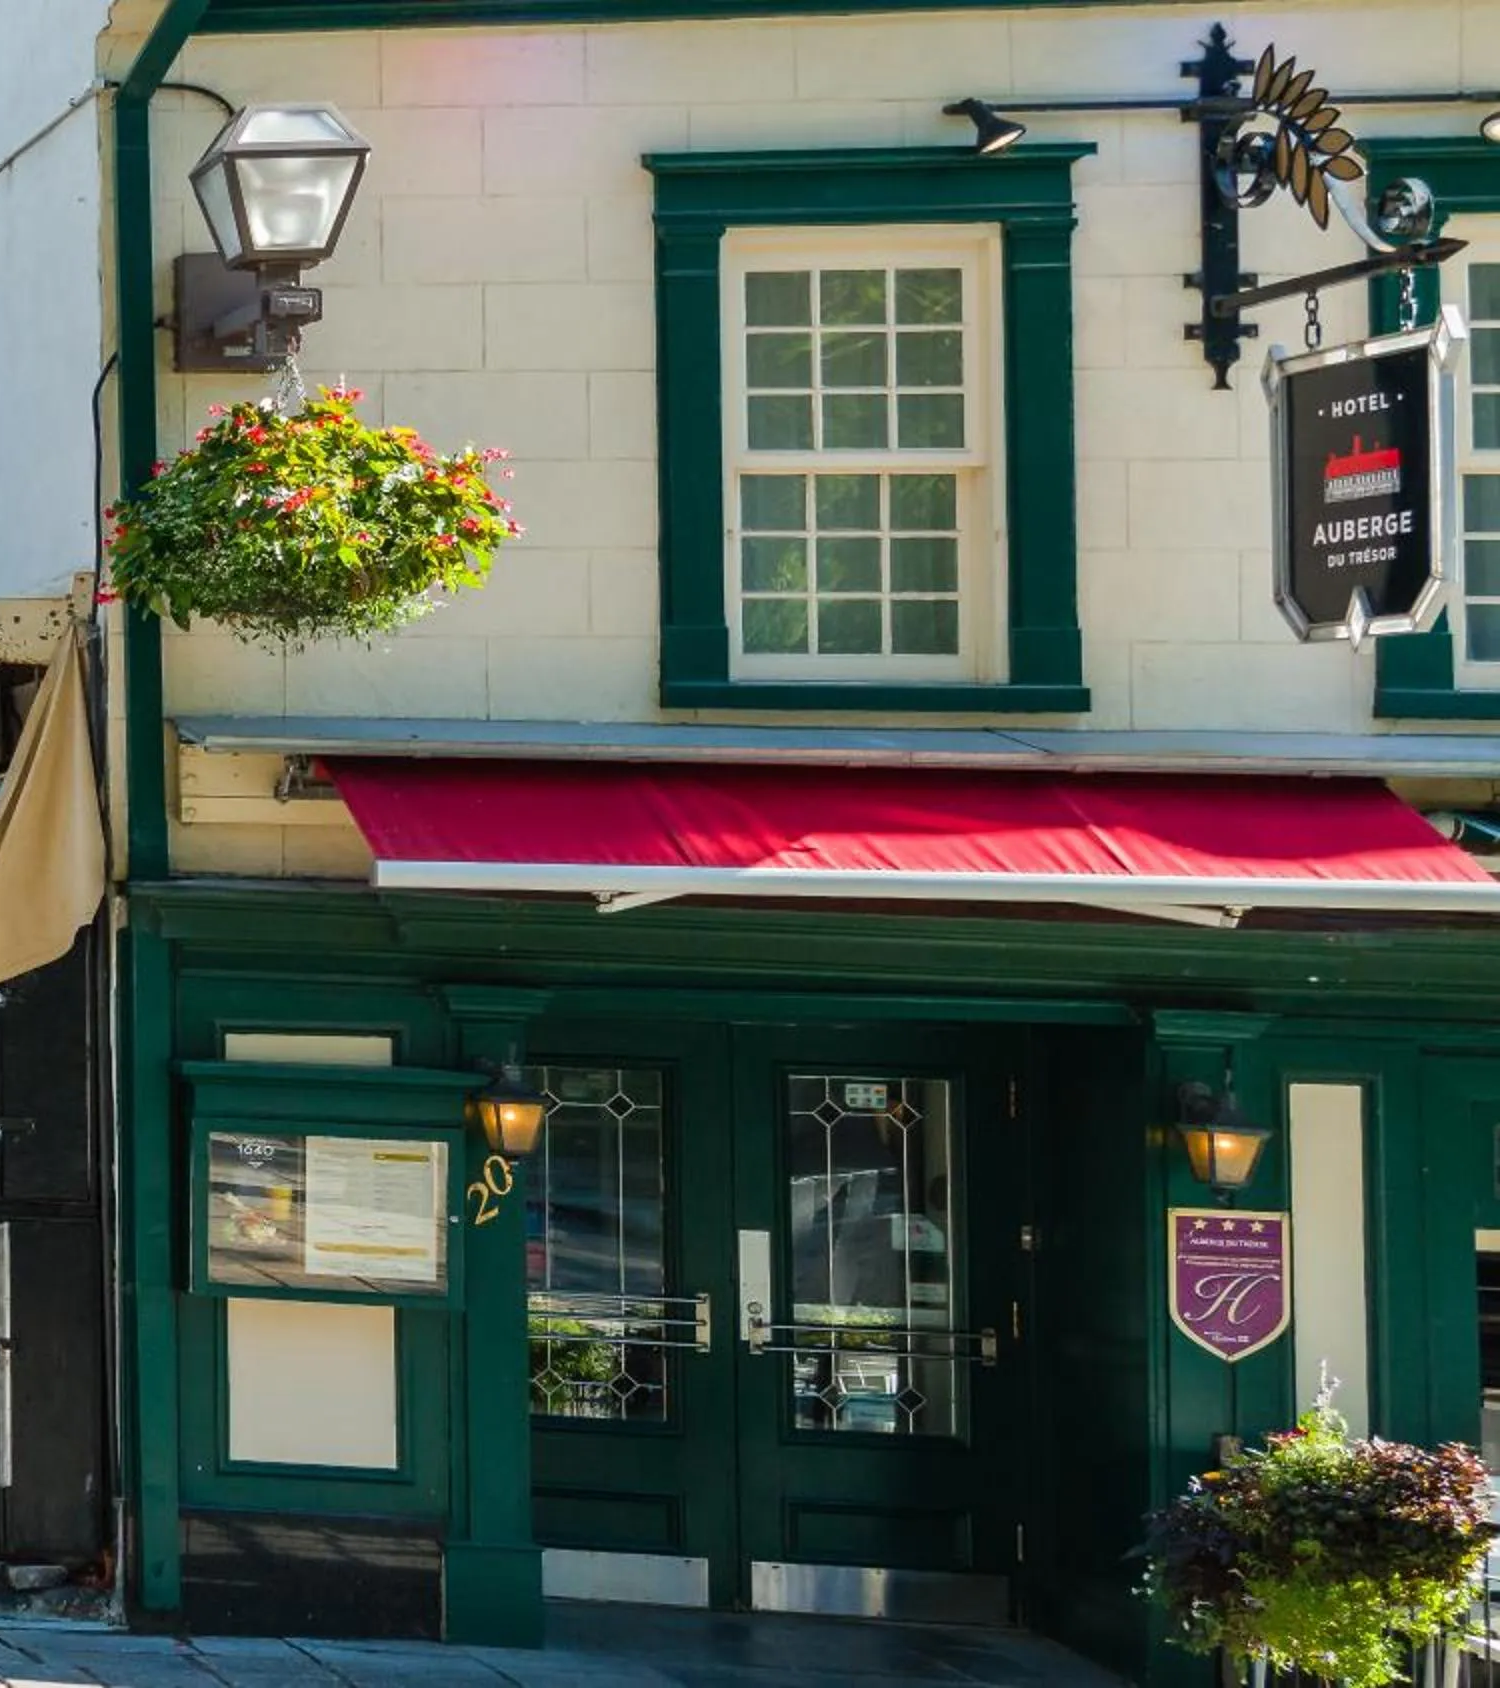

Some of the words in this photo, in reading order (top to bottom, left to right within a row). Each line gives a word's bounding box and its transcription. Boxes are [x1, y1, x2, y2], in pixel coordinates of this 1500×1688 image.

[1331, 392, 1390, 418] HOTEL
[1313, 510, 1413, 547] AUBERGE
[1327, 552, 1345, 568] DU
[1349, 546, 1397, 566] TRÉSOR
[466, 1154, 513, 1226] 20
